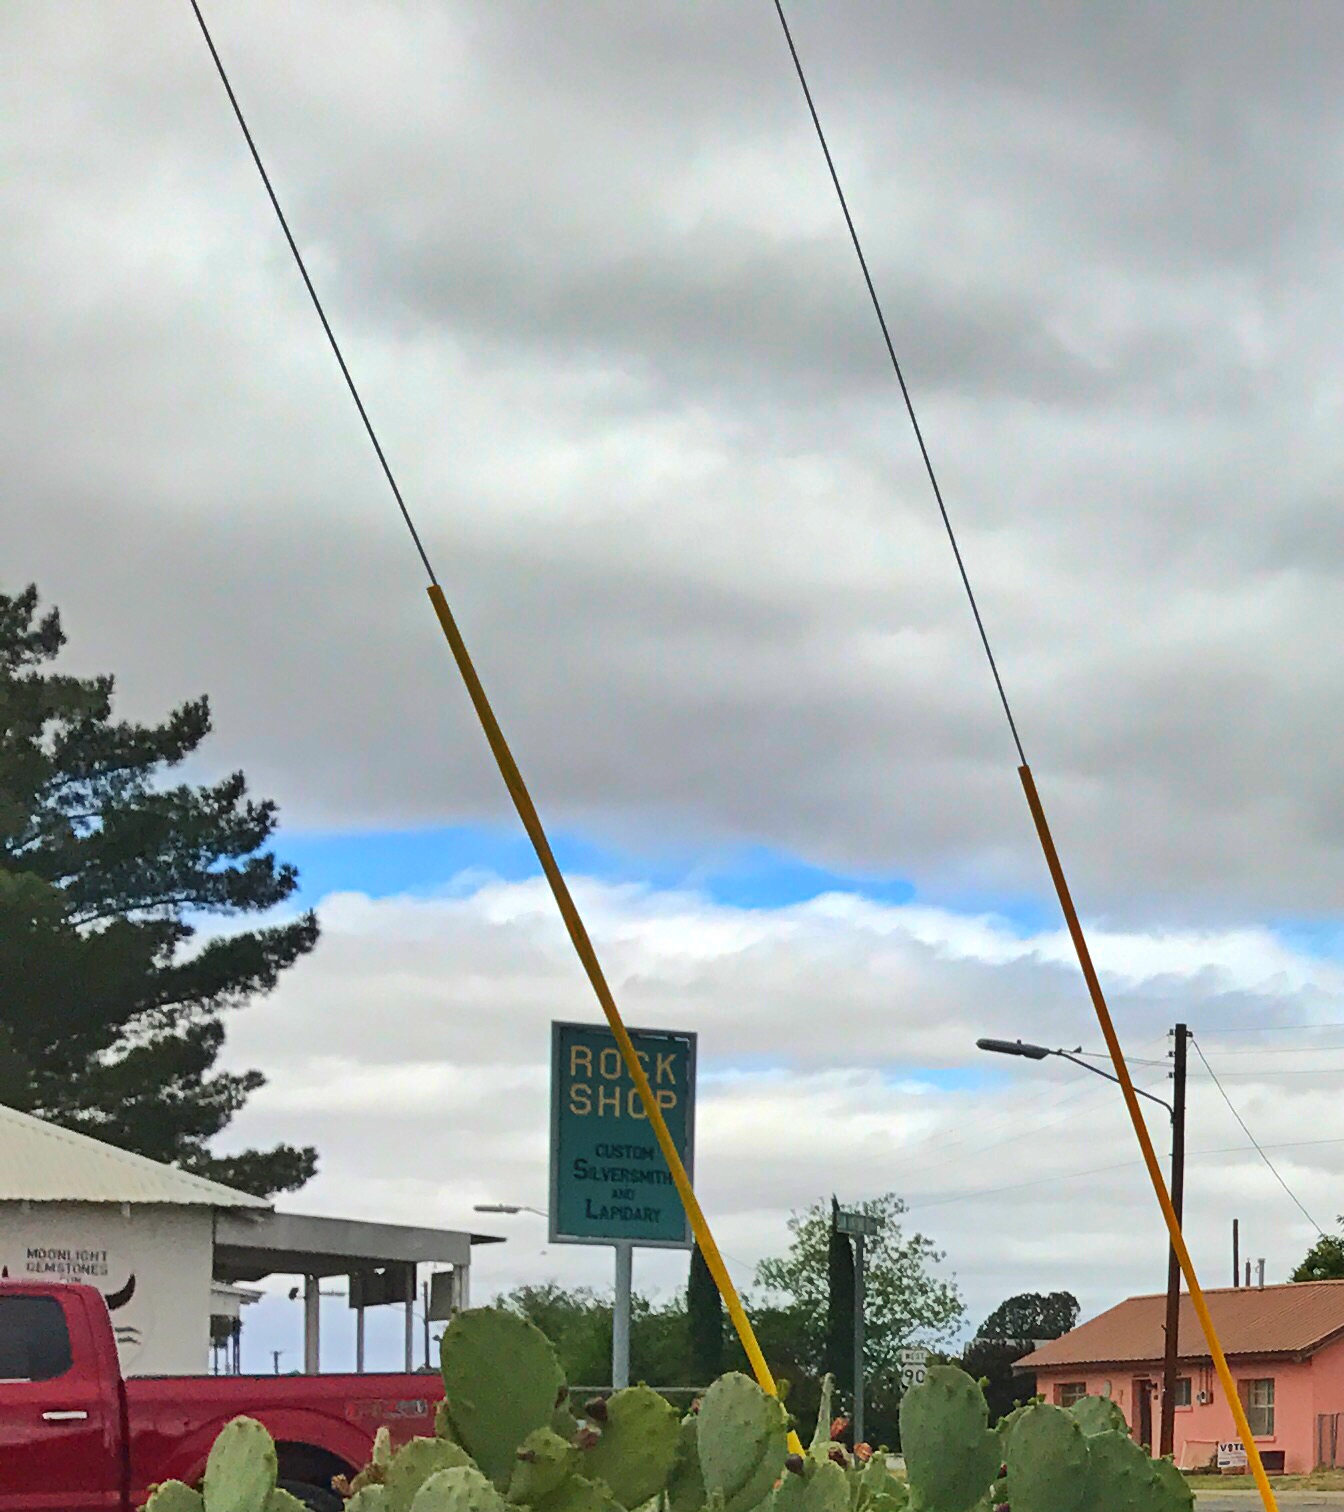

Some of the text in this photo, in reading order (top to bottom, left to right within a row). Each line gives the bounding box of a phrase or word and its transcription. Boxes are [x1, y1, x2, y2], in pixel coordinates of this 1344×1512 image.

[570, 1044, 677, 1085] ROCK
[569, 1082, 678, 1120] SHOP
[595, 1143, 655, 1161] CUSTOM
[573, 1158, 674, 1186] SILVERSMITH
[611, 1188, 636, 1200] AND
[585, 1198, 661, 1224] LAPIDARY
[26, 1247, 107, 1262] MOONLIGHT
[26, 1261, 108, 1276] GEMSTONES
[904, 1369, 926, 1384] 90
